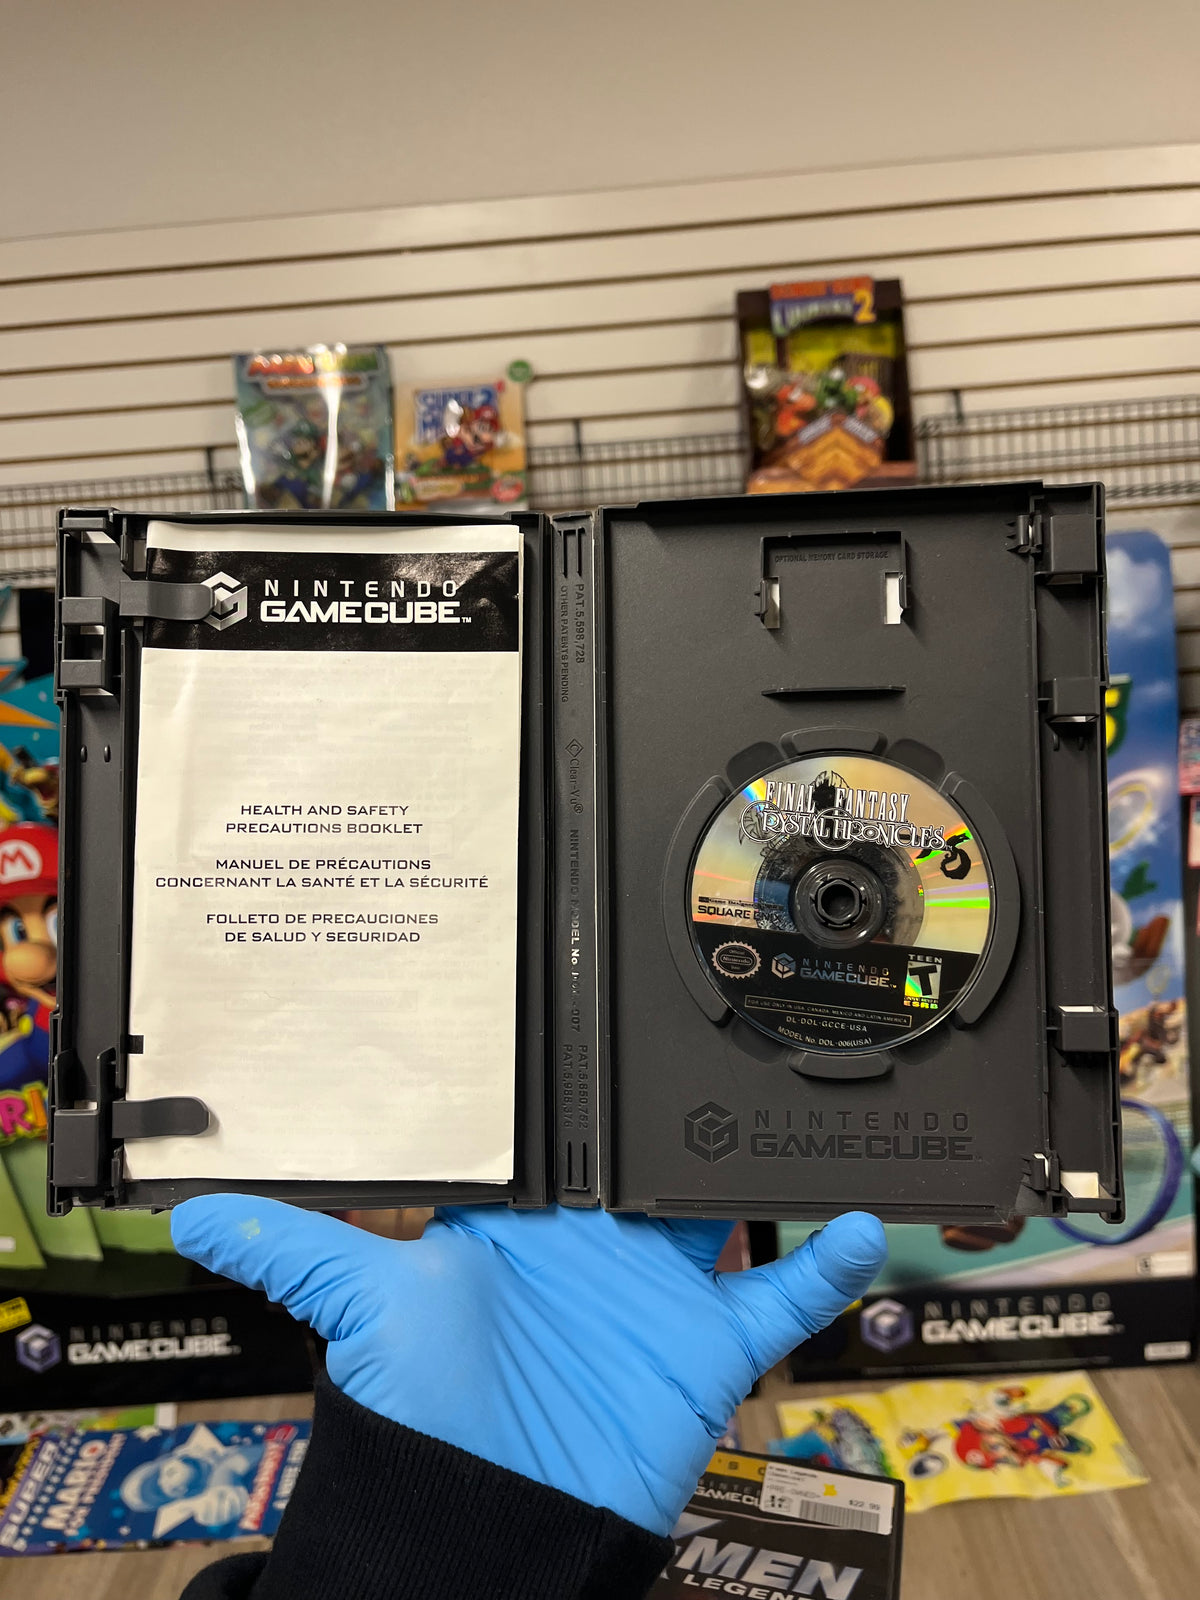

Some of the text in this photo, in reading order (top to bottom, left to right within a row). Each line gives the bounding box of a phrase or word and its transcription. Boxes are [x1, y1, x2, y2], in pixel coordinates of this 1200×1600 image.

[837, 552, 855, 560] CARD
[857, 551, 889, 559] STORAGE
[264, 579, 459, 597] NINTENDO
[561, 662, 569, 703] PENDING
[240, 804, 409, 816] HEALTH AND SAFETY
[766, 781, 911, 823] FINAL FANTASY
[226, 822, 423, 834] PRECAUTIONS BOOKLET
[216, 857, 431, 871] MANUEL DE PRÉCAUTIONS
[155, 874, 489, 888] CONCERNANT LA SANTÉ ET LA SÉCURITÉ
[206, 913, 439, 925] FOLLETO DE PRECAUCIONES
[698, 905, 751, 919] SQUARE
[225, 931, 421, 943] DE SALUD Y SEGURIDAD
[908, 954, 942, 963] TEEN
[802, 958, 889, 976] NINTENDO
[909, 965, 937, 995] T
[786, 1016, 867, 1032] DL-DOL-GCCE-USA
[778, 1026, 803, 1040] MODEL
[754, 1109, 969, 1132] NINTENDO
[924, 1292, 1111, 1318] NINTENDO
[69, 1316, 228, 1341] NINTENDO
[41, 1439, 107, 1530] MARIO
[674, 1535, 863, 1600] MEN
